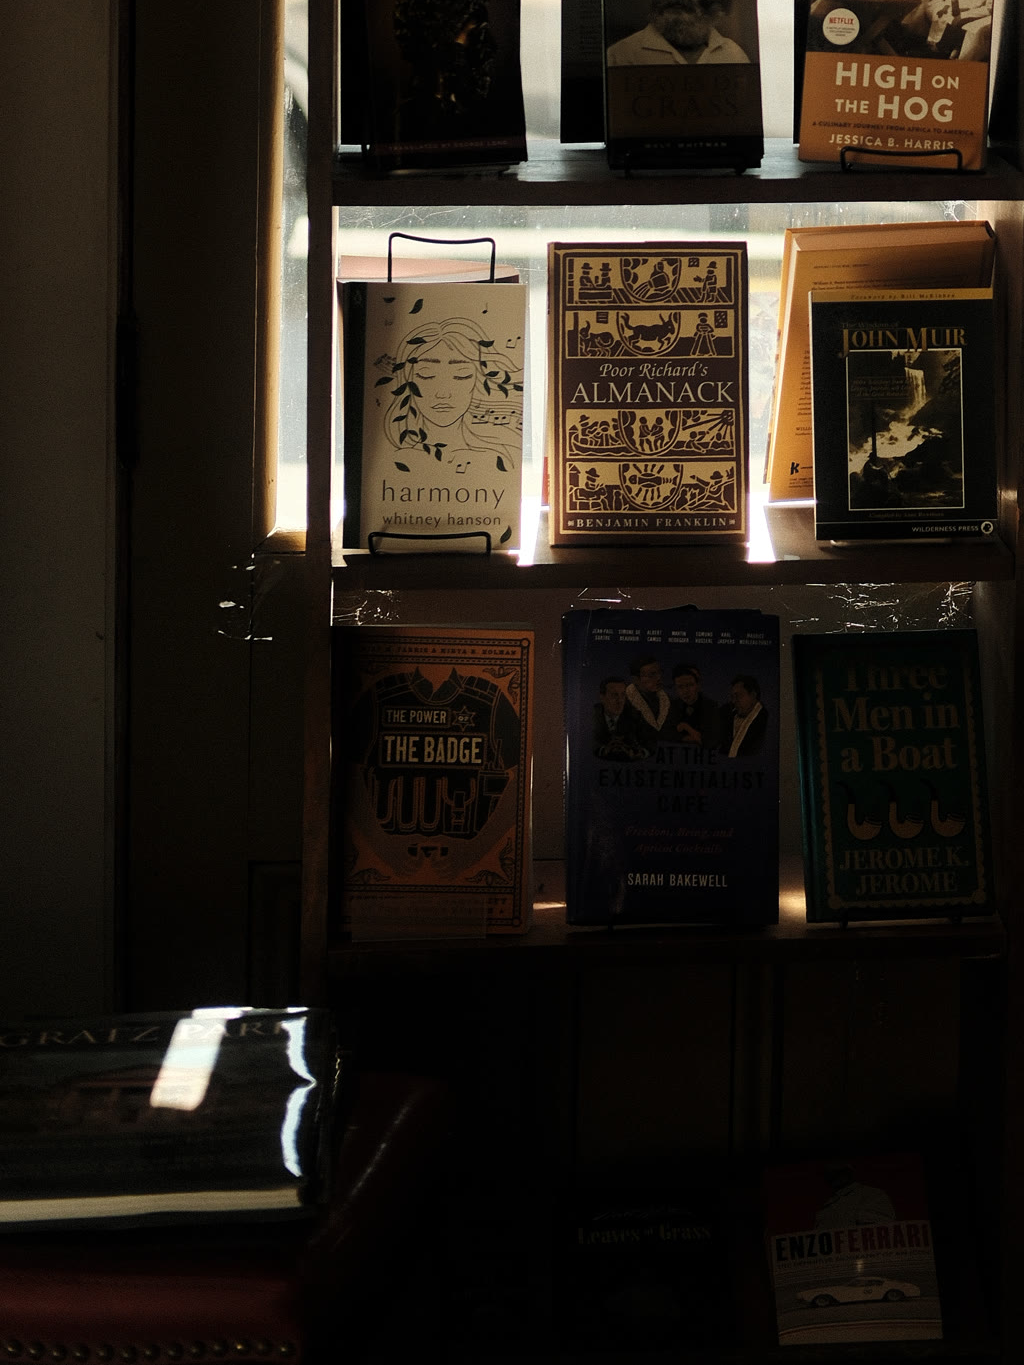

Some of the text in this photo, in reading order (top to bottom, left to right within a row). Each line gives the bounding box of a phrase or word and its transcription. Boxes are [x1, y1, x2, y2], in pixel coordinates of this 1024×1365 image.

[829, 17, 854, 25] NETFLIX
[835, 61, 960, 91] HIGH ON
[835, 94, 954, 123] THE HOG
[853, 122, 886, 130] JOURNEY
[943, 128, 974, 136] AMERICA
[829, 134, 954, 150] JESSICA B. HARRIS
[839, 326, 968, 357] JOHN MUIR
[599, 362, 708, 380] Poor Richard's
[570, 380, 735, 404] ALMANACK
[381, 479, 505, 509] harmony
[382, 512, 501, 527] whitney hanson
[576, 517, 727, 528] BENJAMIN FRANKLIN
[911, 525, 957, 533] WILDERNESS
[385, 709, 448, 725] THE POWER
[832, 690, 961, 732] Men in
[383, 735, 483, 765] THE BADGE
[683, 747, 716, 765] THE
[840, 735, 959, 772] a Boat
[599, 770, 766, 788] EXISTENTIALIST
[839, 845, 969, 870] JEROME K.
[627, 872, 729, 888] SARAH BAKEWELL
[855, 871, 961, 896] JEROME
[576, 1223, 713, 1245] Leaves Grass
